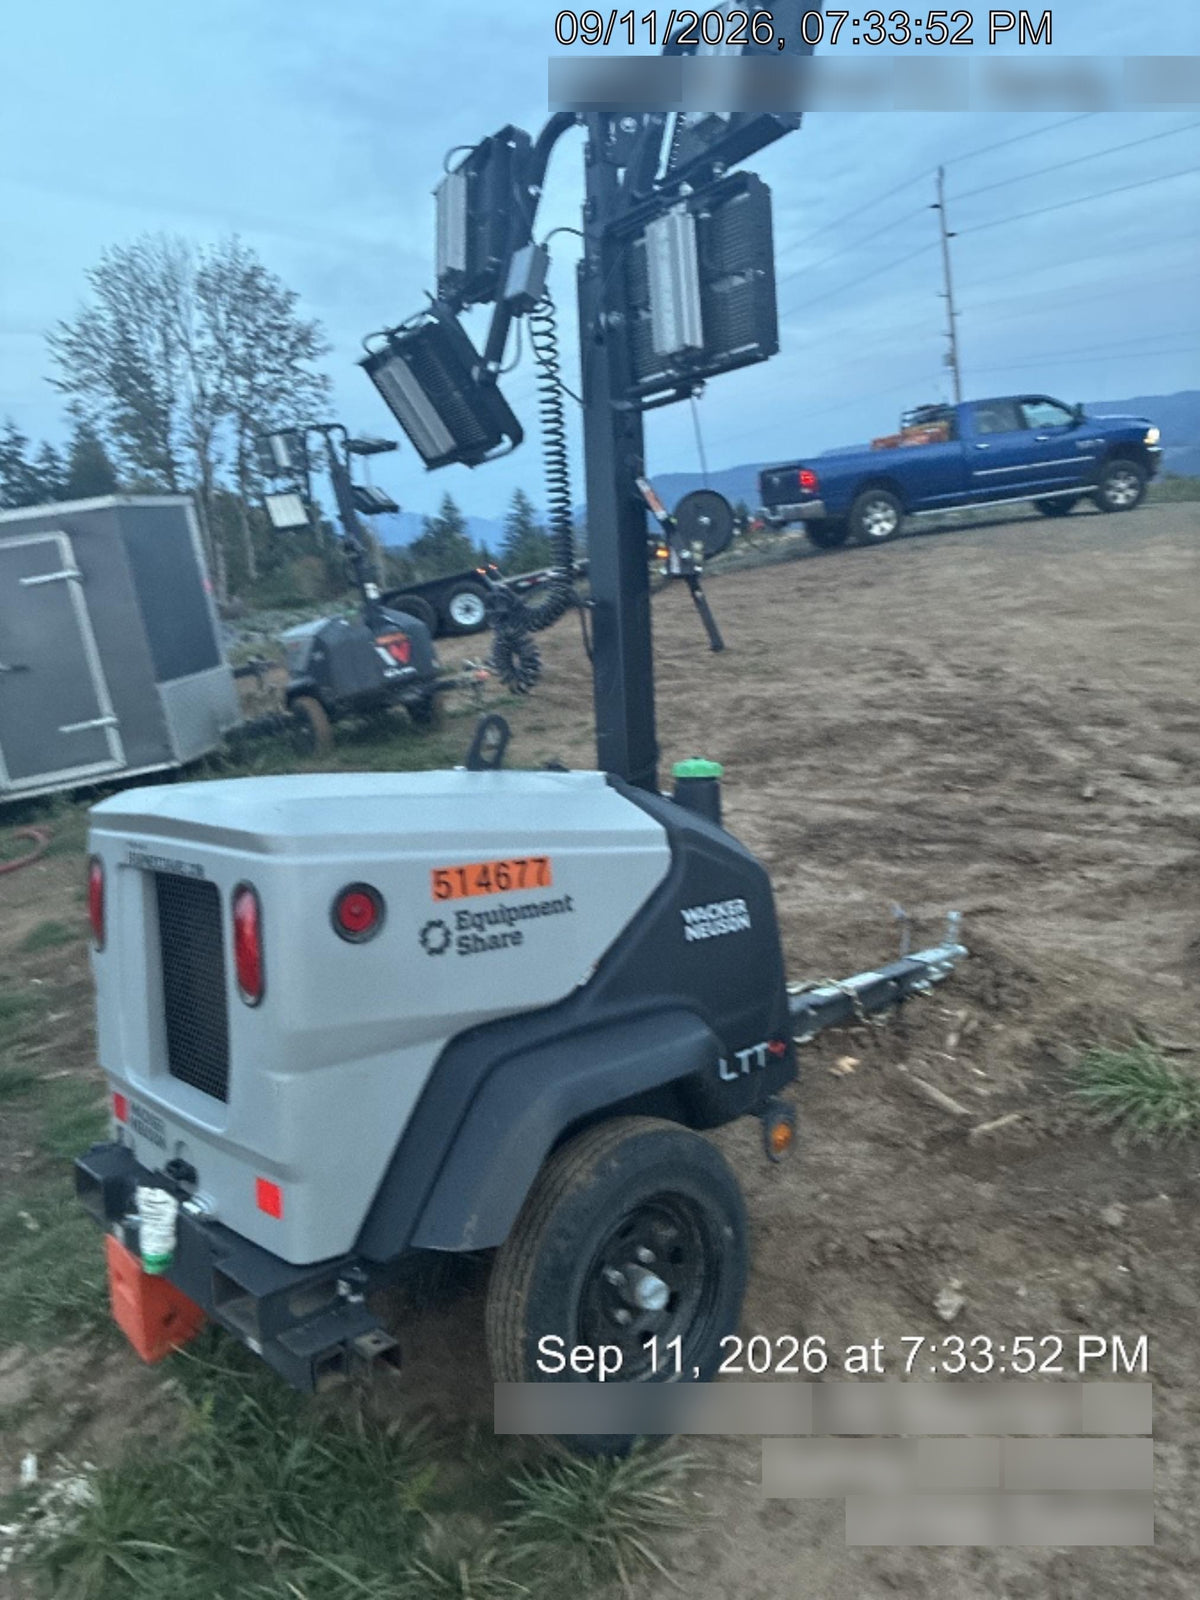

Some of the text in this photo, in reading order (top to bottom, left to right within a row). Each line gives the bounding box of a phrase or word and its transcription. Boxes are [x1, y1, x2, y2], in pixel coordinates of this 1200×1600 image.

[432, 857, 547, 900] 514677
[454, 894, 574, 932] Equipment
[456, 931, 524, 956] Share
